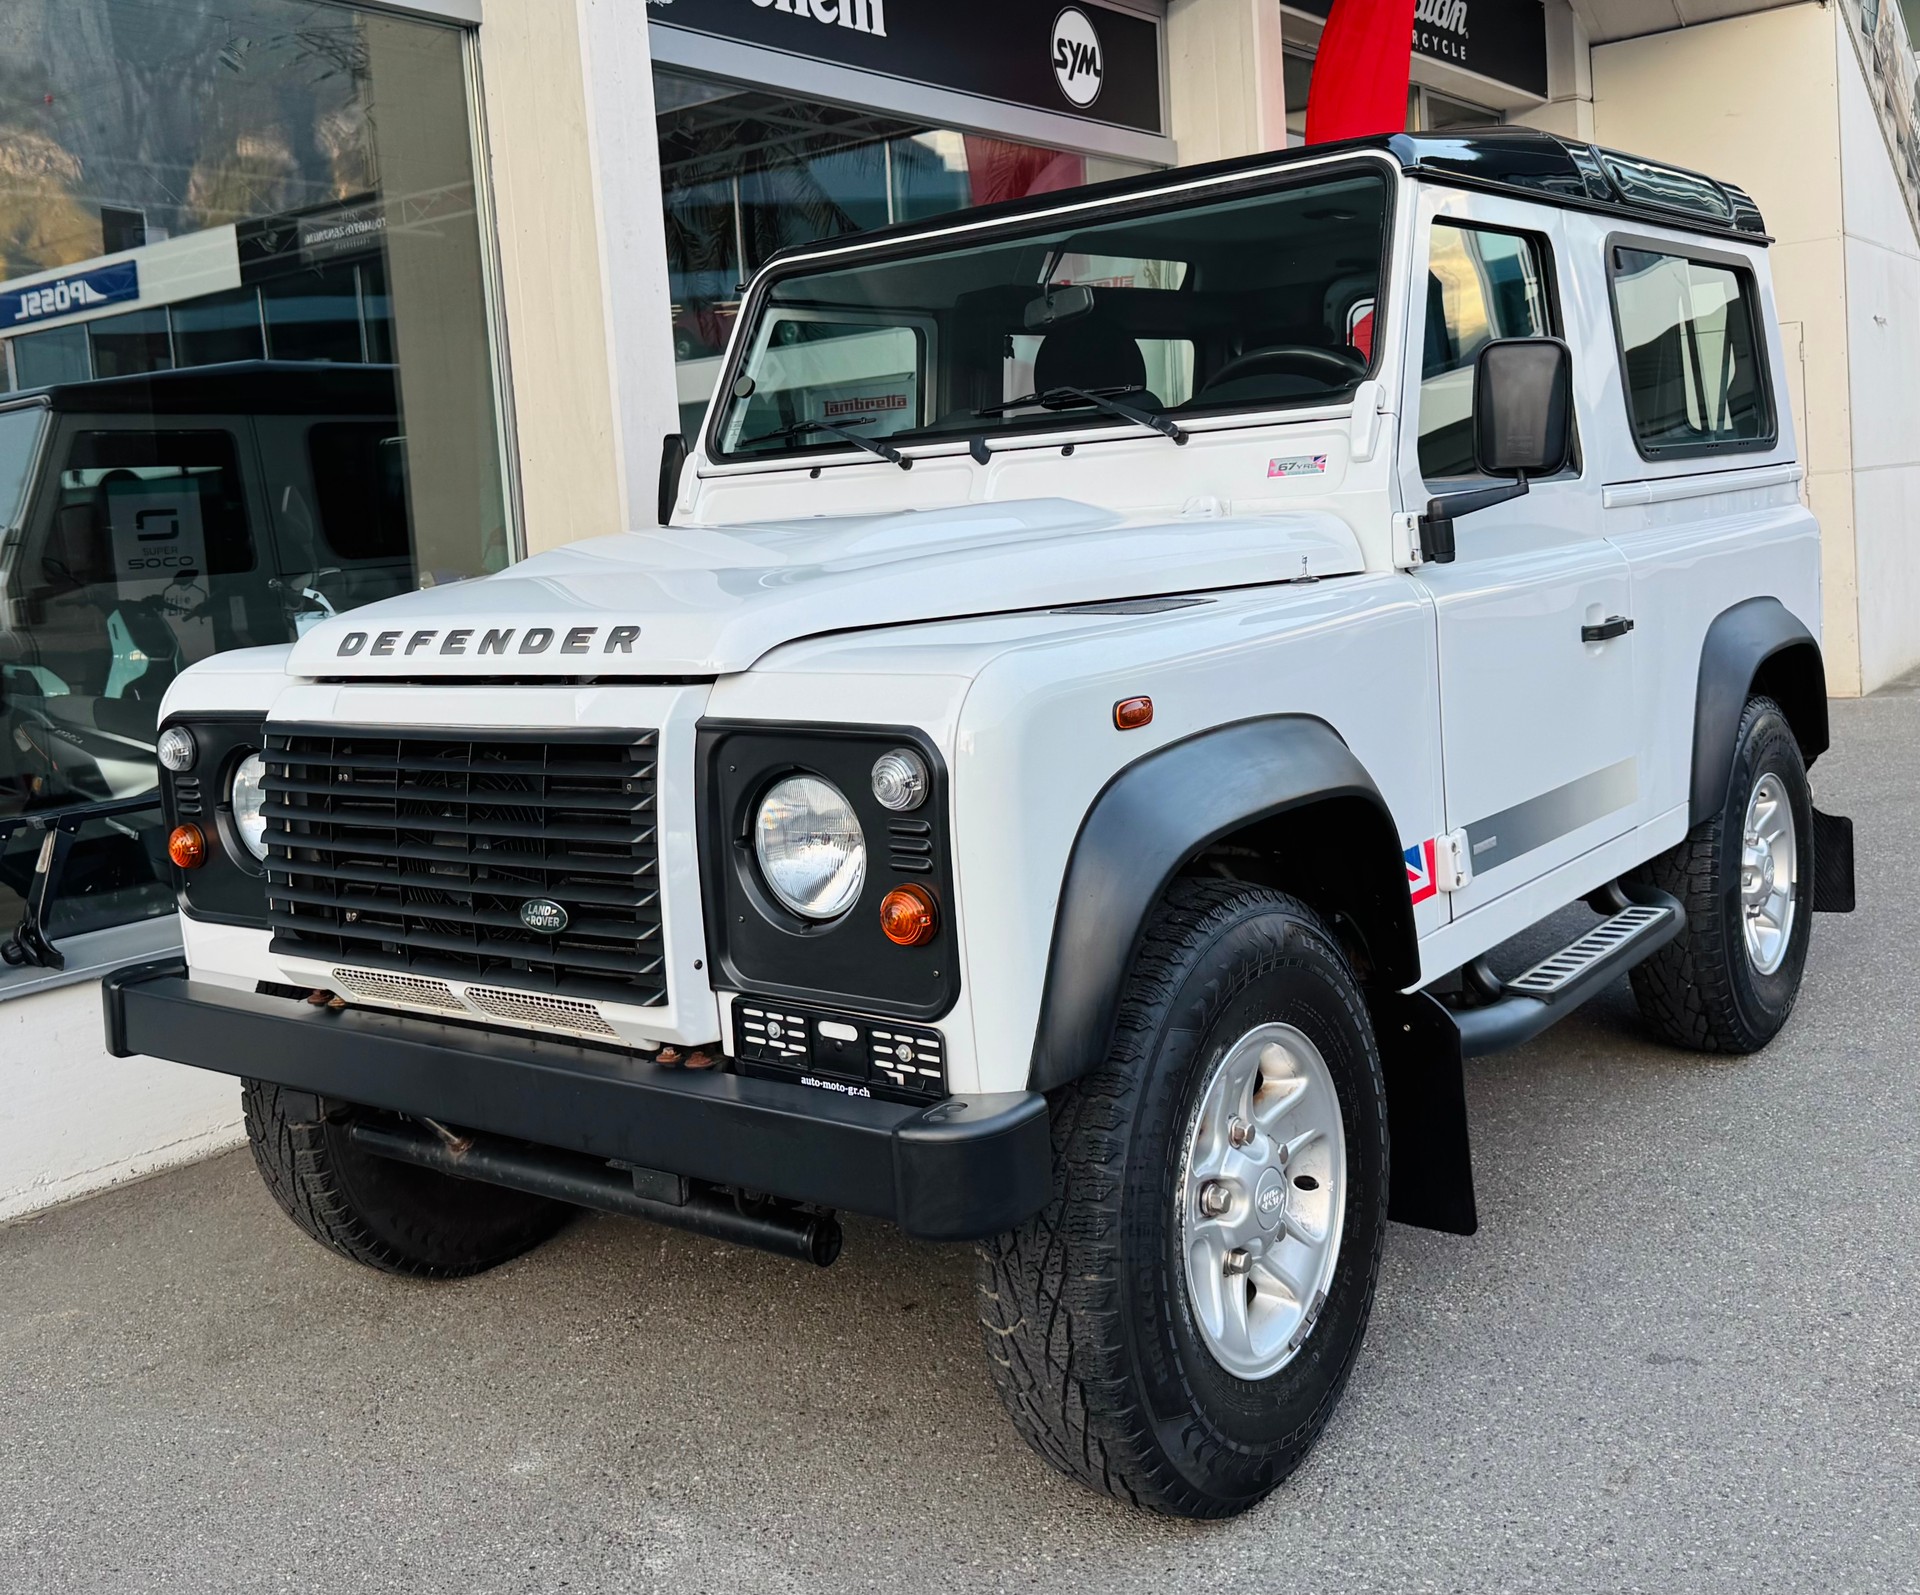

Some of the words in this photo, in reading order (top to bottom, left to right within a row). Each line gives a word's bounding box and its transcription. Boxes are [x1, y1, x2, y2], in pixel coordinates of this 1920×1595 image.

[1412, 29, 1466, 60] RCYCLE
[1053, 37, 1101, 81] SYM
[142, 545, 179, 557] SUPER
[128, 556, 195, 570] SOCO
[336, 625, 642, 657] DEFENDER
[528, 904, 552, 916] LAND
[530, 915, 560, 927] ROVER
